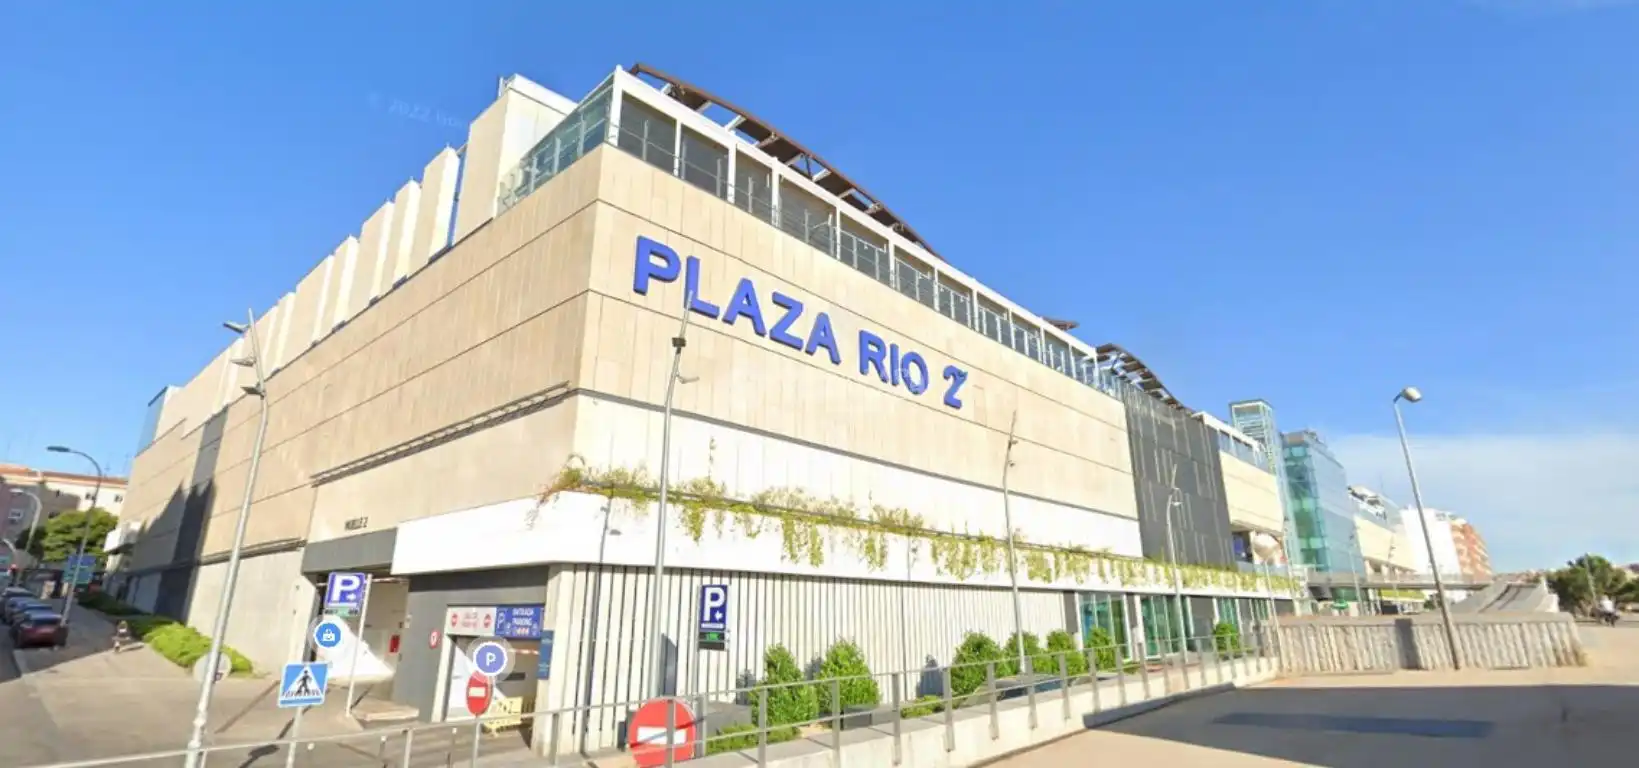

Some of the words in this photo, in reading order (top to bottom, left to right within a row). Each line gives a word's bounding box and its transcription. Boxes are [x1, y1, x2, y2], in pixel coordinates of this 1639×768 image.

[633, 235, 842, 366] PLAZA
[858, 328, 930, 396] RIO
[942, 365, 968, 409] 2
[330, 574, 361, 603] P
[703, 587, 726, 622] P
